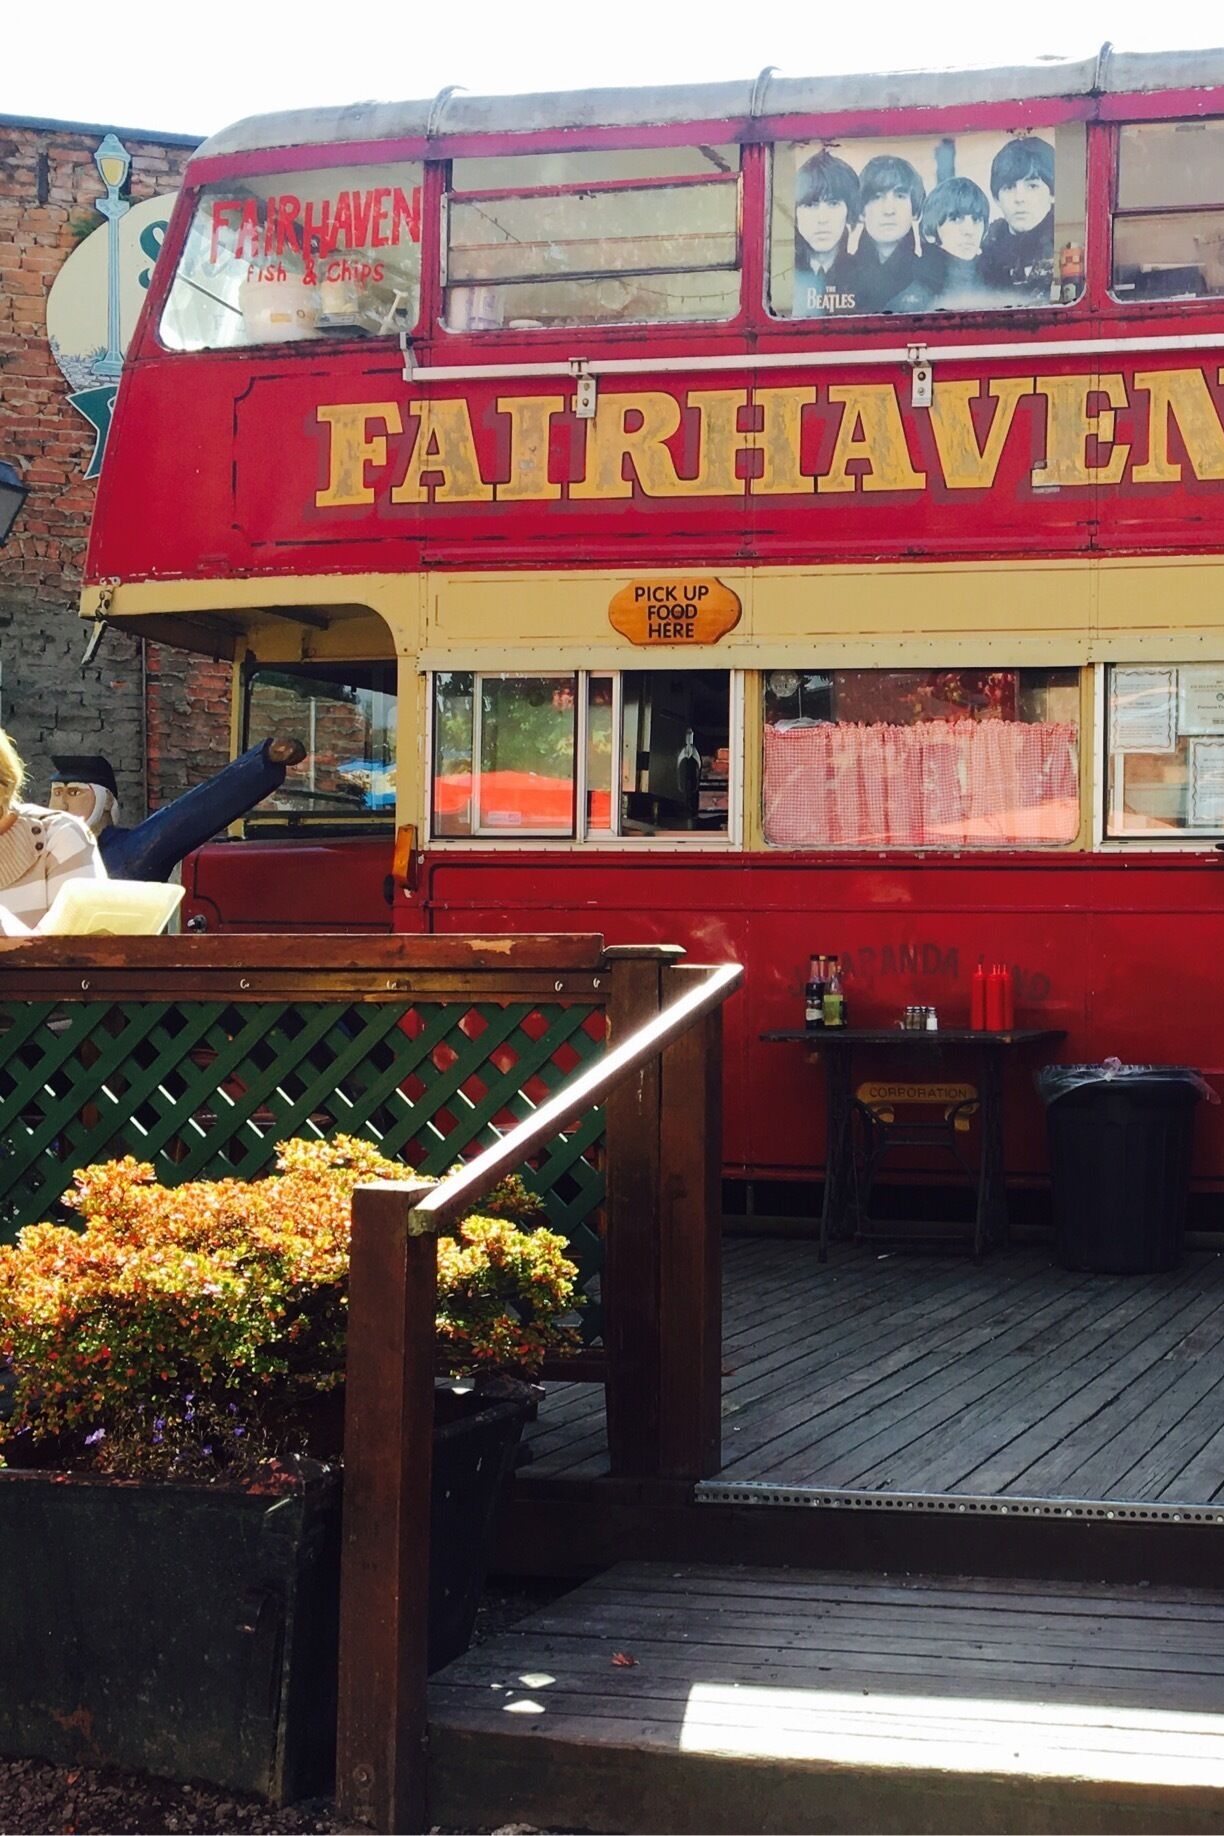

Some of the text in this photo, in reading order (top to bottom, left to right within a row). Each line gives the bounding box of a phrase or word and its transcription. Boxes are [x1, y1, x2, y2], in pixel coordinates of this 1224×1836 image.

[210, 187, 422, 264] FAIRHAVEN
[303, 259, 317, 286] &
[635, 585, 709, 602] PICK UP
[648, 604, 698, 621] FOOD
[648, 622, 694, 638] HERE
